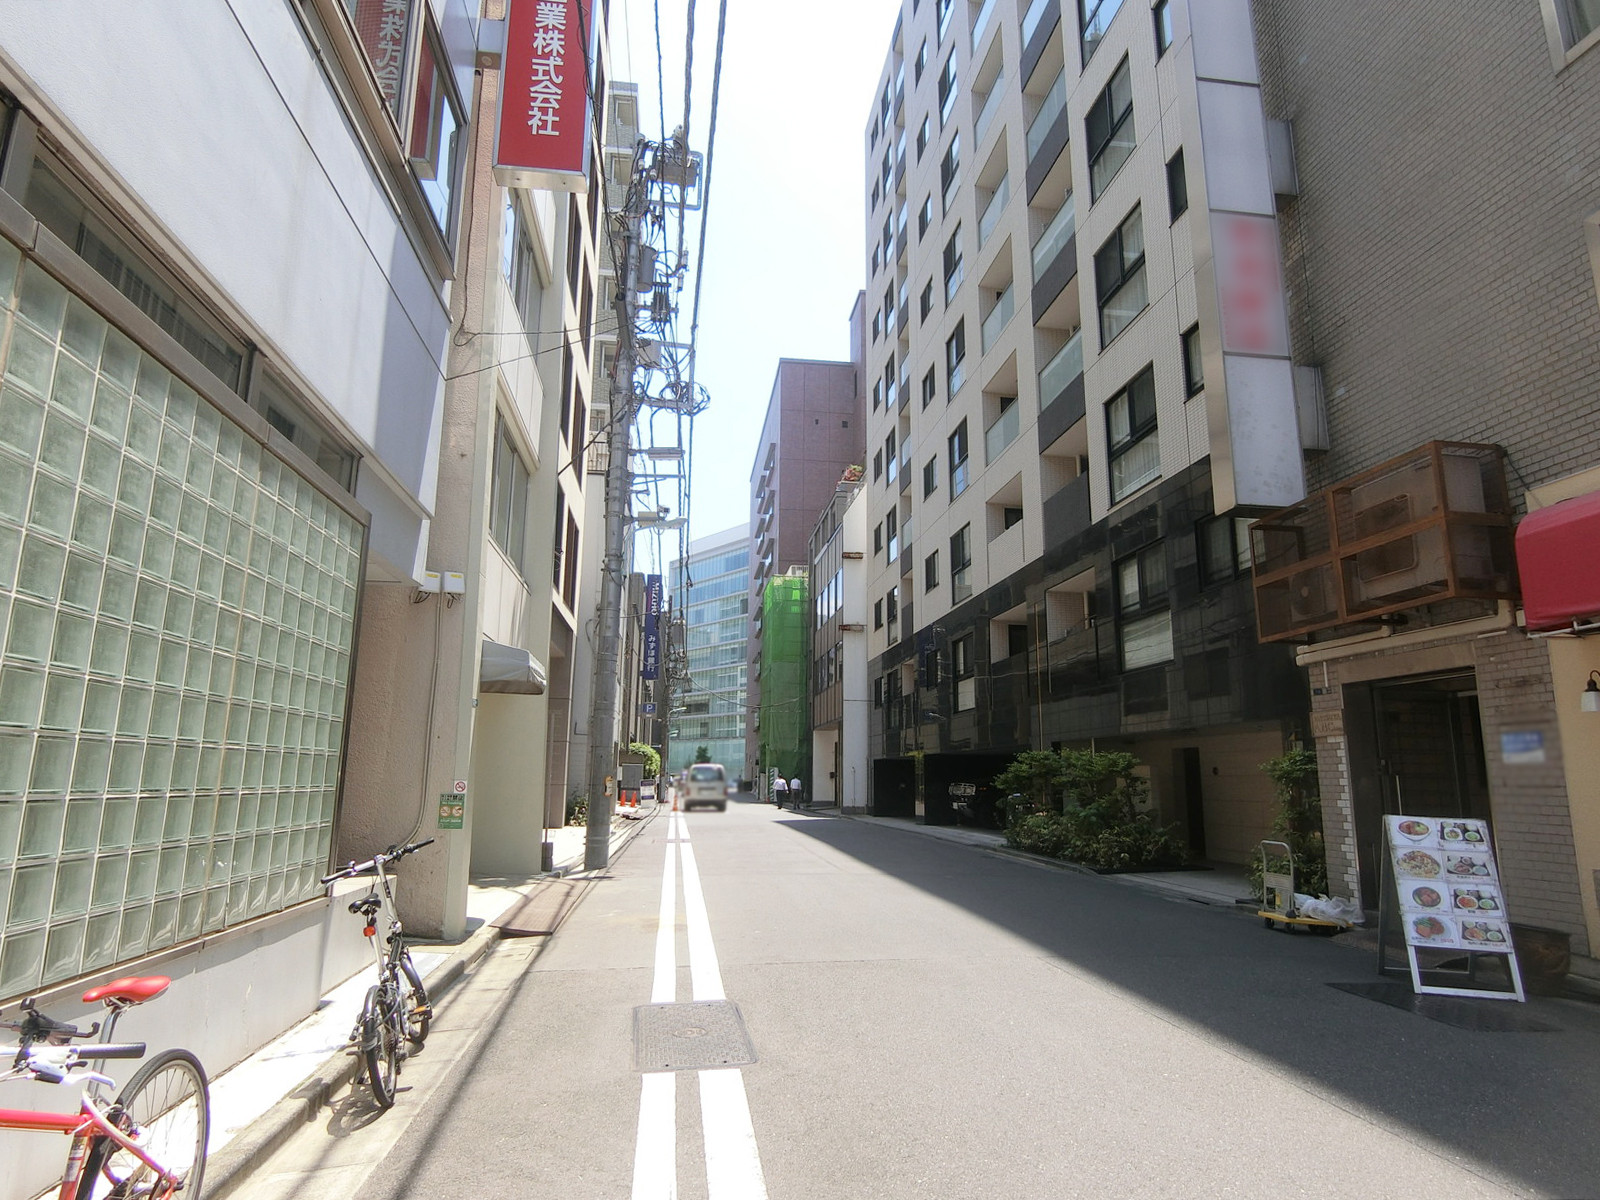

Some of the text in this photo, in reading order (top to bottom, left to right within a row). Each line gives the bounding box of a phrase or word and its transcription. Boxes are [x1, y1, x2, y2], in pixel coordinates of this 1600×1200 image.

[527, 0, 567, 136] 業株式会社
[648, 634, 656, 672] みずほ銀行
[646, 704, 653, 712] P
